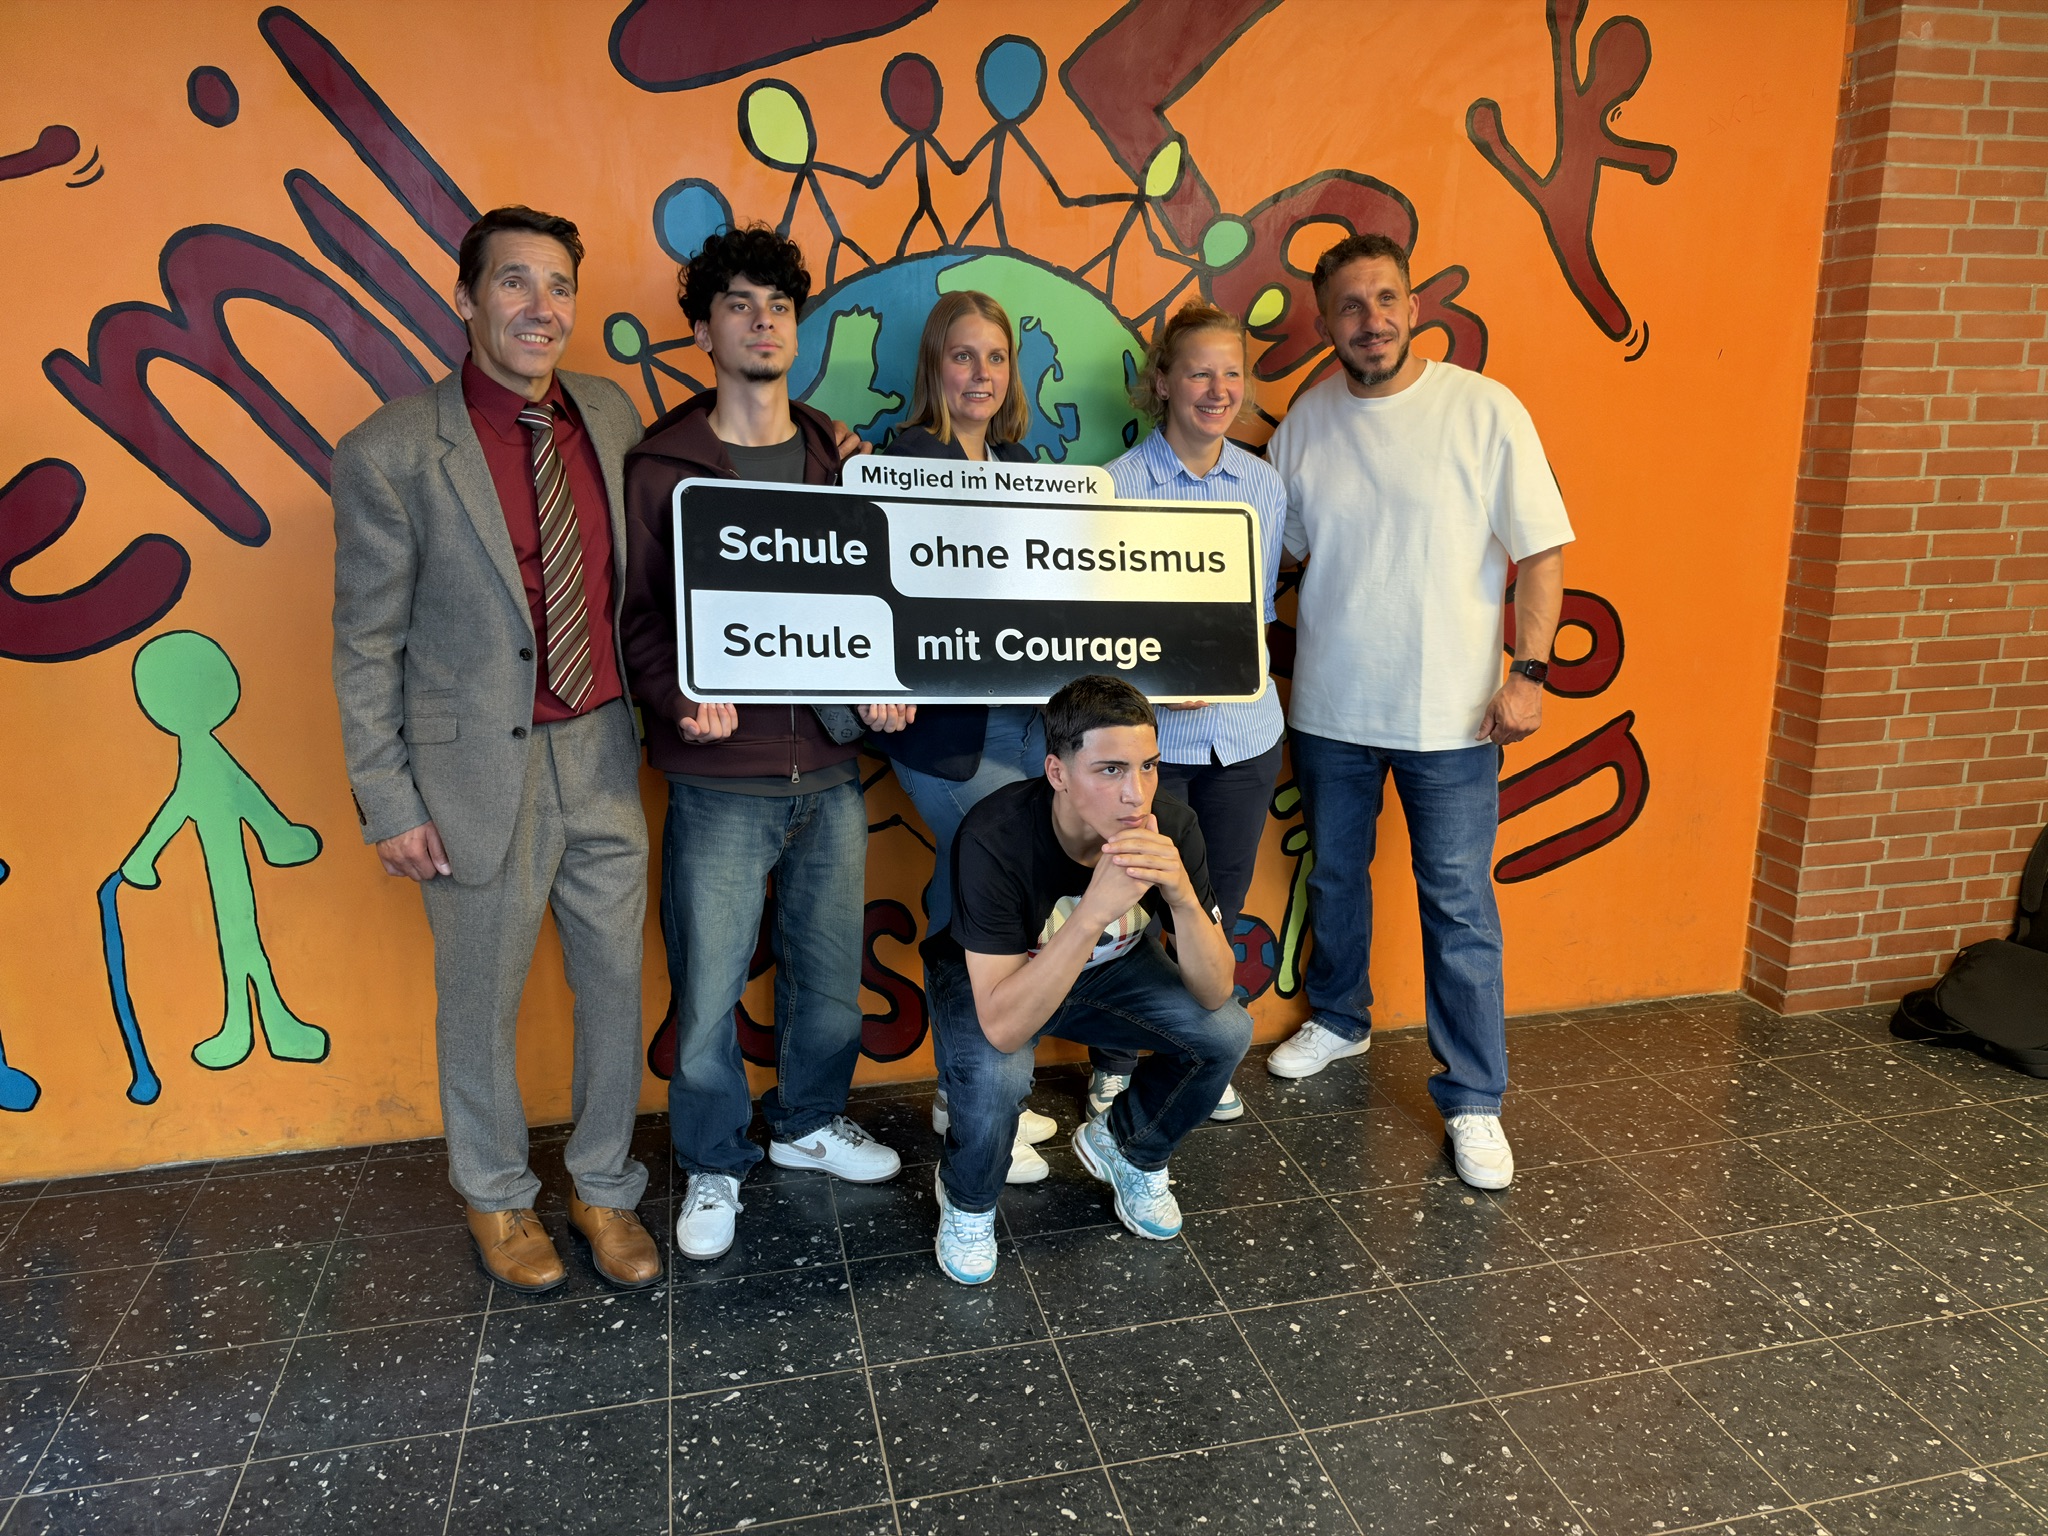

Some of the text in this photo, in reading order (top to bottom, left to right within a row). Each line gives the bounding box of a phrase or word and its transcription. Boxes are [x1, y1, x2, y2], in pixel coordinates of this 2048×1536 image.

[861, 465, 1098, 495] Mitglied im Netzwerk
[719, 525, 1226, 573] Schule ohne Rassismus
[723, 622, 1162, 670] Schule mit Courage
